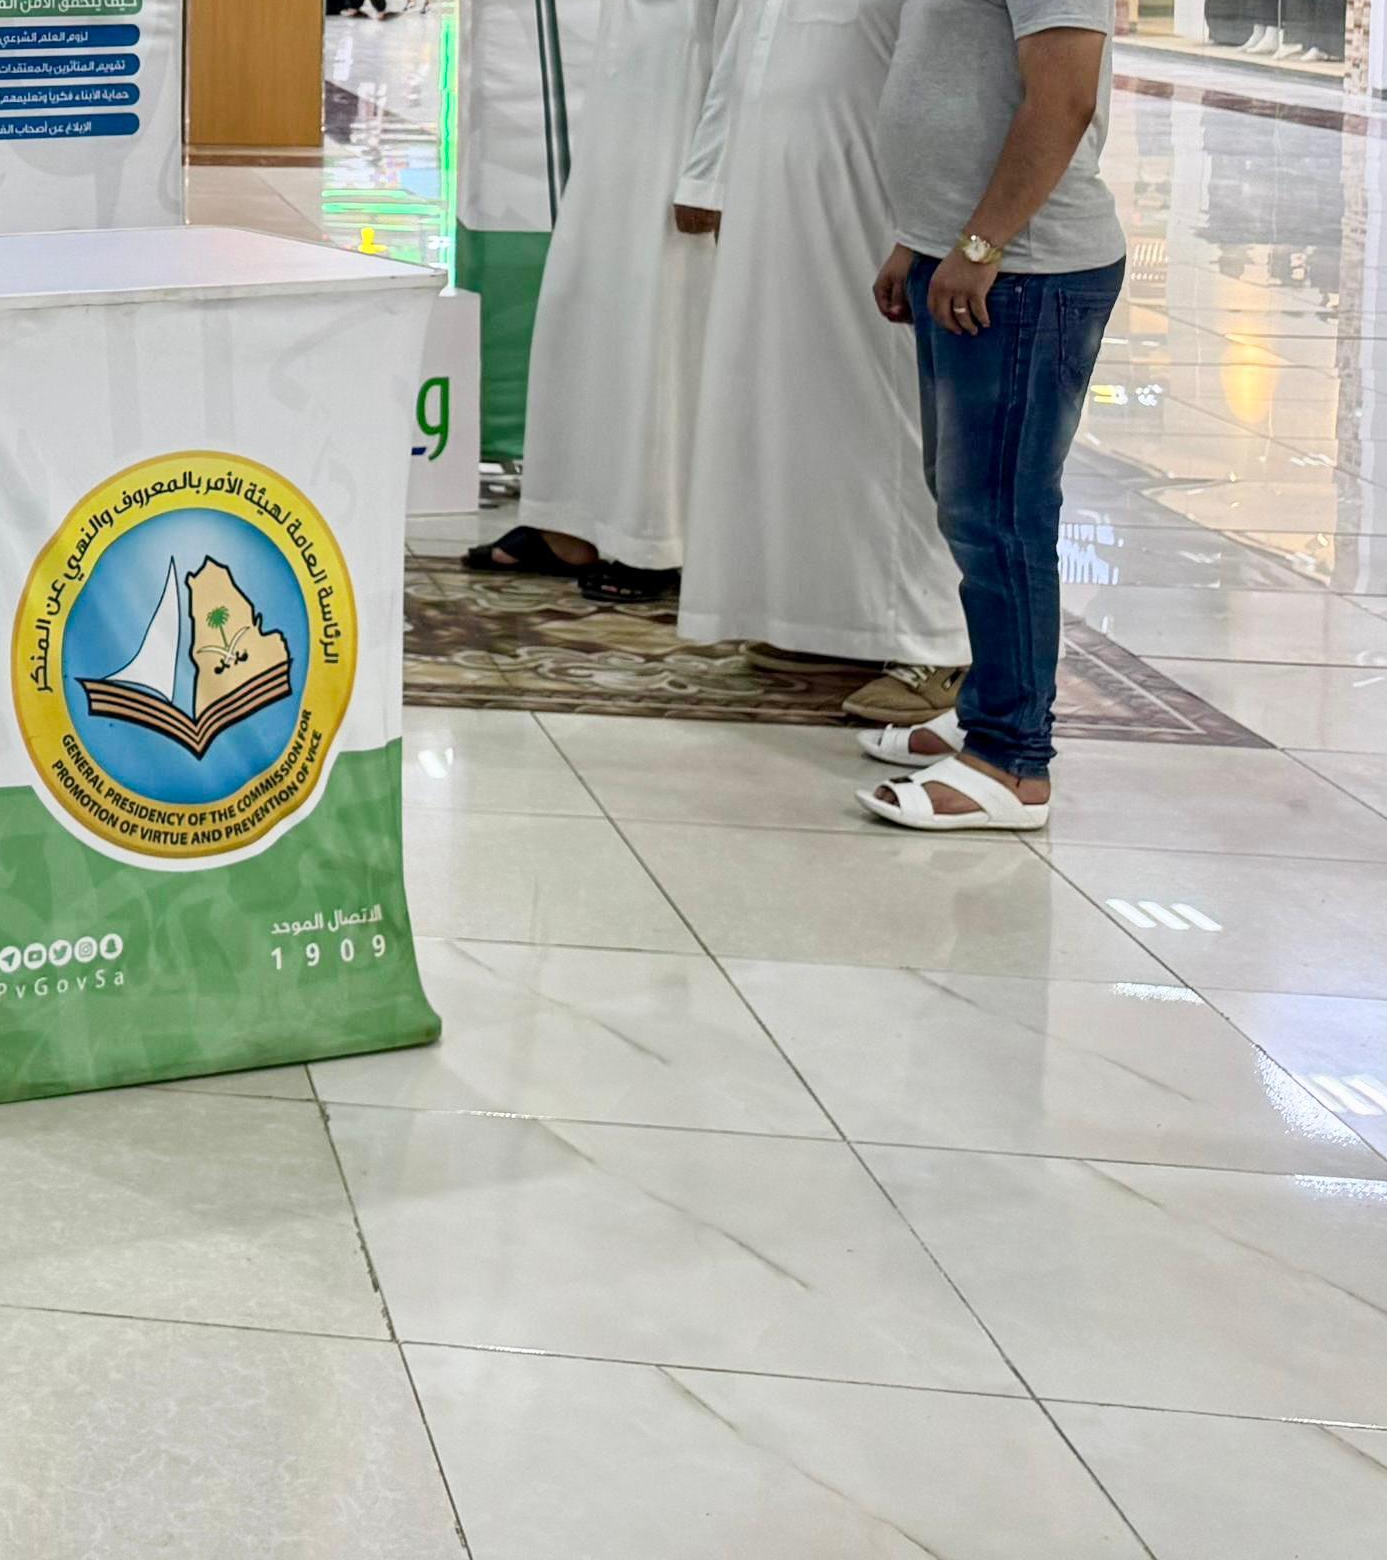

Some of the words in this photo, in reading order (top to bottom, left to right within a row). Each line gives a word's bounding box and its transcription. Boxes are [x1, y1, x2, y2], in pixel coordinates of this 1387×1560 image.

[113, 471, 203, 515] بالمعروف
[202, 471, 244, 497] الأمر
[243, 481, 292, 526] لهيئة
[63, 508, 115, 583] والنهي
[286, 518, 328, 585] العامة
[46, 578, 67, 617] عن
[317, 585, 341, 665] الرئاسة
[29, 617, 53, 693] المنكر
[51, 759, 120, 829] PROMOTION
[119, 820, 140, 837] OF
[139, 826, 189, 846] VIRTUE
[190, 827, 223, 846] AND
[225, 781, 300, 839] PREVENTION
[295, 761, 311, 785] OF
[305, 728, 323, 764] VICE
[61, 733, 104, 795] GENERAL
[103, 787, 185, 827] PRESIDENCY
[187, 811, 207, 827] OF
[208, 804, 236, 824] THE
[236, 741, 304, 814] COMMISSION
[297, 708, 313, 743] FOR
[270, 911, 326, 935] الموحد
[327, 902, 384, 931] الاتصال
